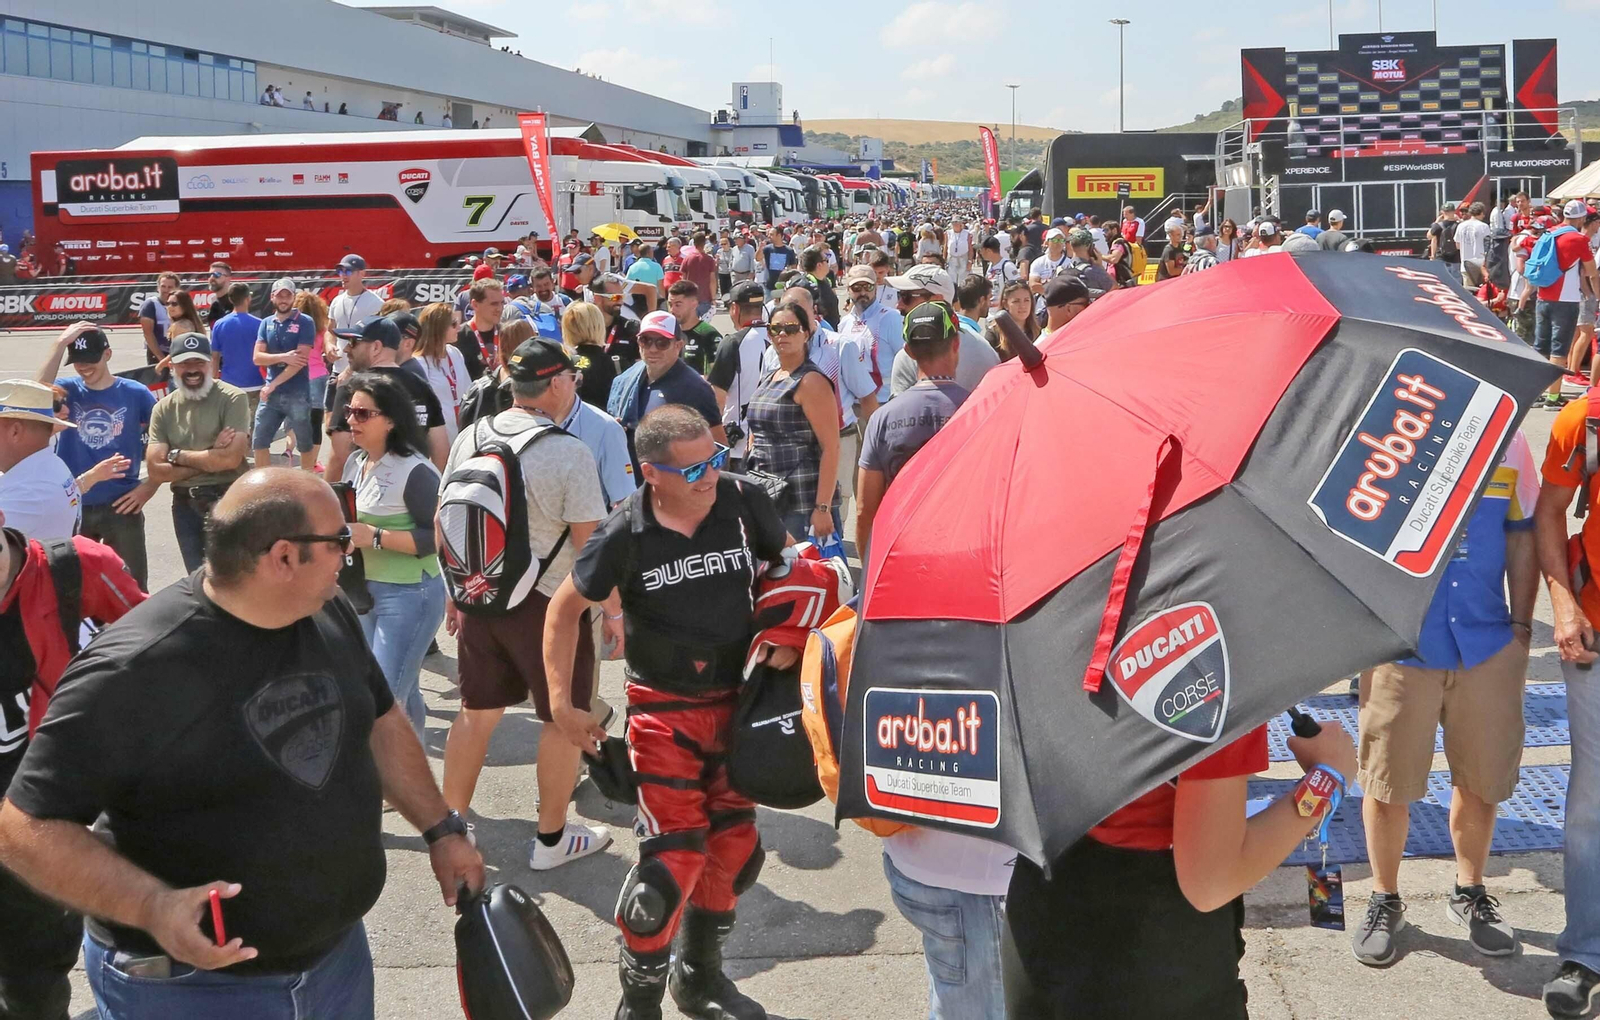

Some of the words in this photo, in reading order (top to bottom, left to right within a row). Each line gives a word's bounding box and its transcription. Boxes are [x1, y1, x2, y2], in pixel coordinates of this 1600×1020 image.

[1372, 60, 1400, 70] SBK
[1374, 70, 1404, 78] MOTUL
[1, 162, 7, 179] 5
[1384, 163, 1445, 172] #ESPWorldSBK
[1514, 159, 1571, 167] MOTORSPORT.
[70, 162, 163, 192] aruba.it
[187, 182, 215, 190] CLOUD
[104, 204, 138, 213] Superbike
[462, 195, 496, 226] 7
[60, 240, 92, 249] IRELLI
[415, 284, 461, 302] SBK
[50, 296, 104, 310] MOTUL
[88, 435, 104, 444] USA
[1346, 374, 1446, 521] aruba.it
[1399, 419, 1452, 504] RACING
[1409, 490, 1439, 533] Ducati
[1432, 442, 1468, 494] Superbike
[1458, 415, 1482, 444] Team
[642, 547, 752, 591] DUCATI
[1120, 613, 1205, 680] DUCATI
[1162, 672, 1219, 718] CORSE
[878, 697, 982, 756] aruba.it
[896, 756, 959, 773] RACING
[887, 774, 911, 790] Ducati
[912, 778, 949, 795] Superbike
[950, 782, 972, 797] Team
[1309, 770, 1323, 788] ESP
